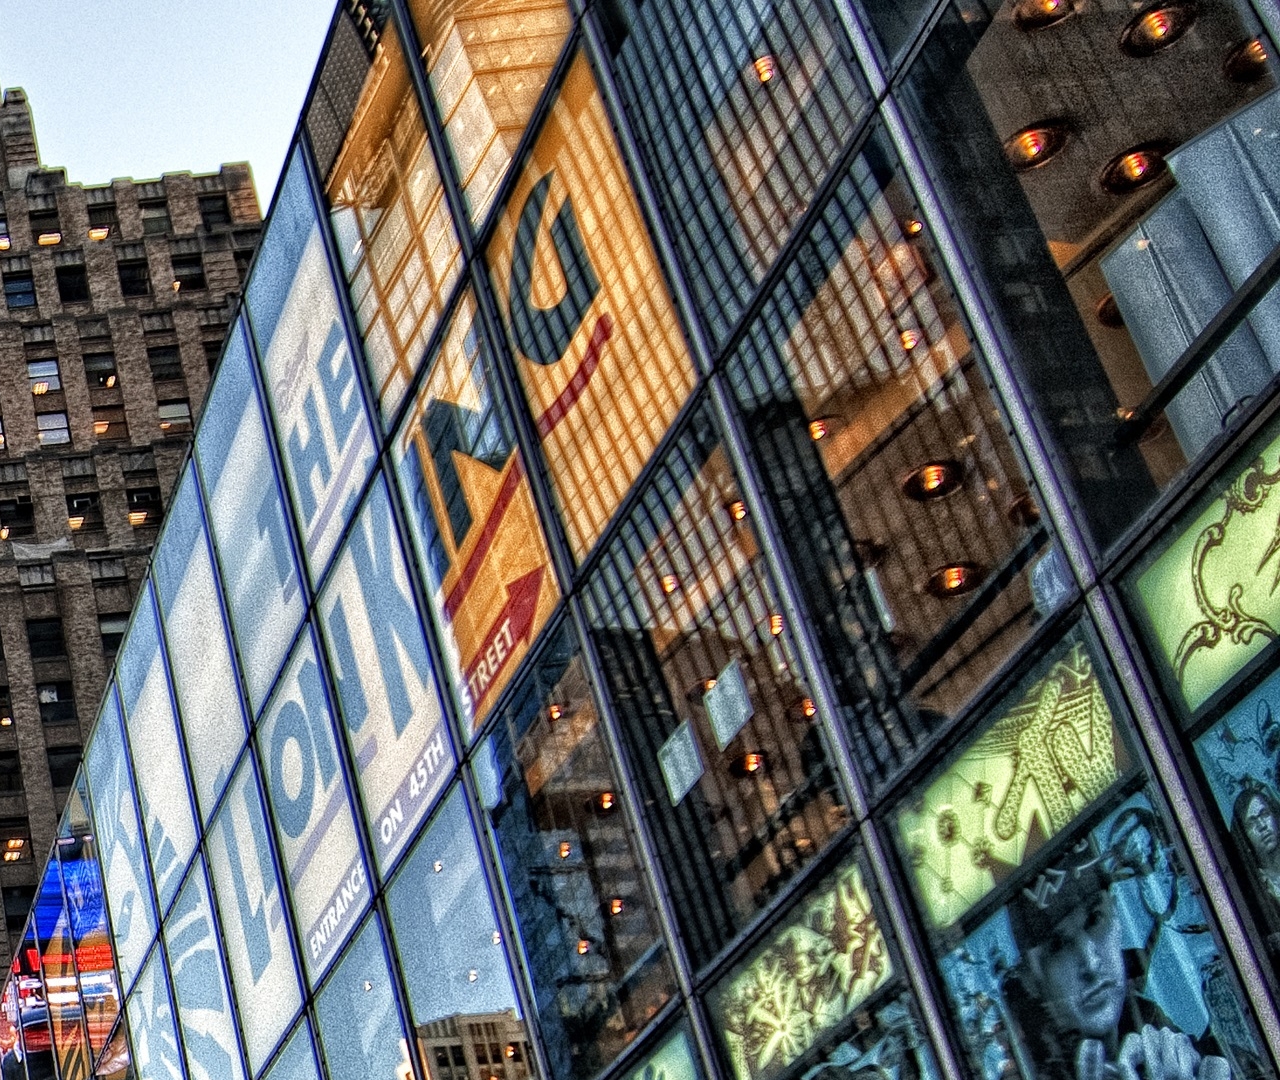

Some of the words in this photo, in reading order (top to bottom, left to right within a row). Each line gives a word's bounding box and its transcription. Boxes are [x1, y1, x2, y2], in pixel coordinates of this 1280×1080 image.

[256, 317, 363, 587] THE
[309, 862, 367, 960] ENTRANCE
[379, 806, 405, 847] ON
[407, 740, 446, 797] 45TH
[460, 616, 516, 714] STREET
